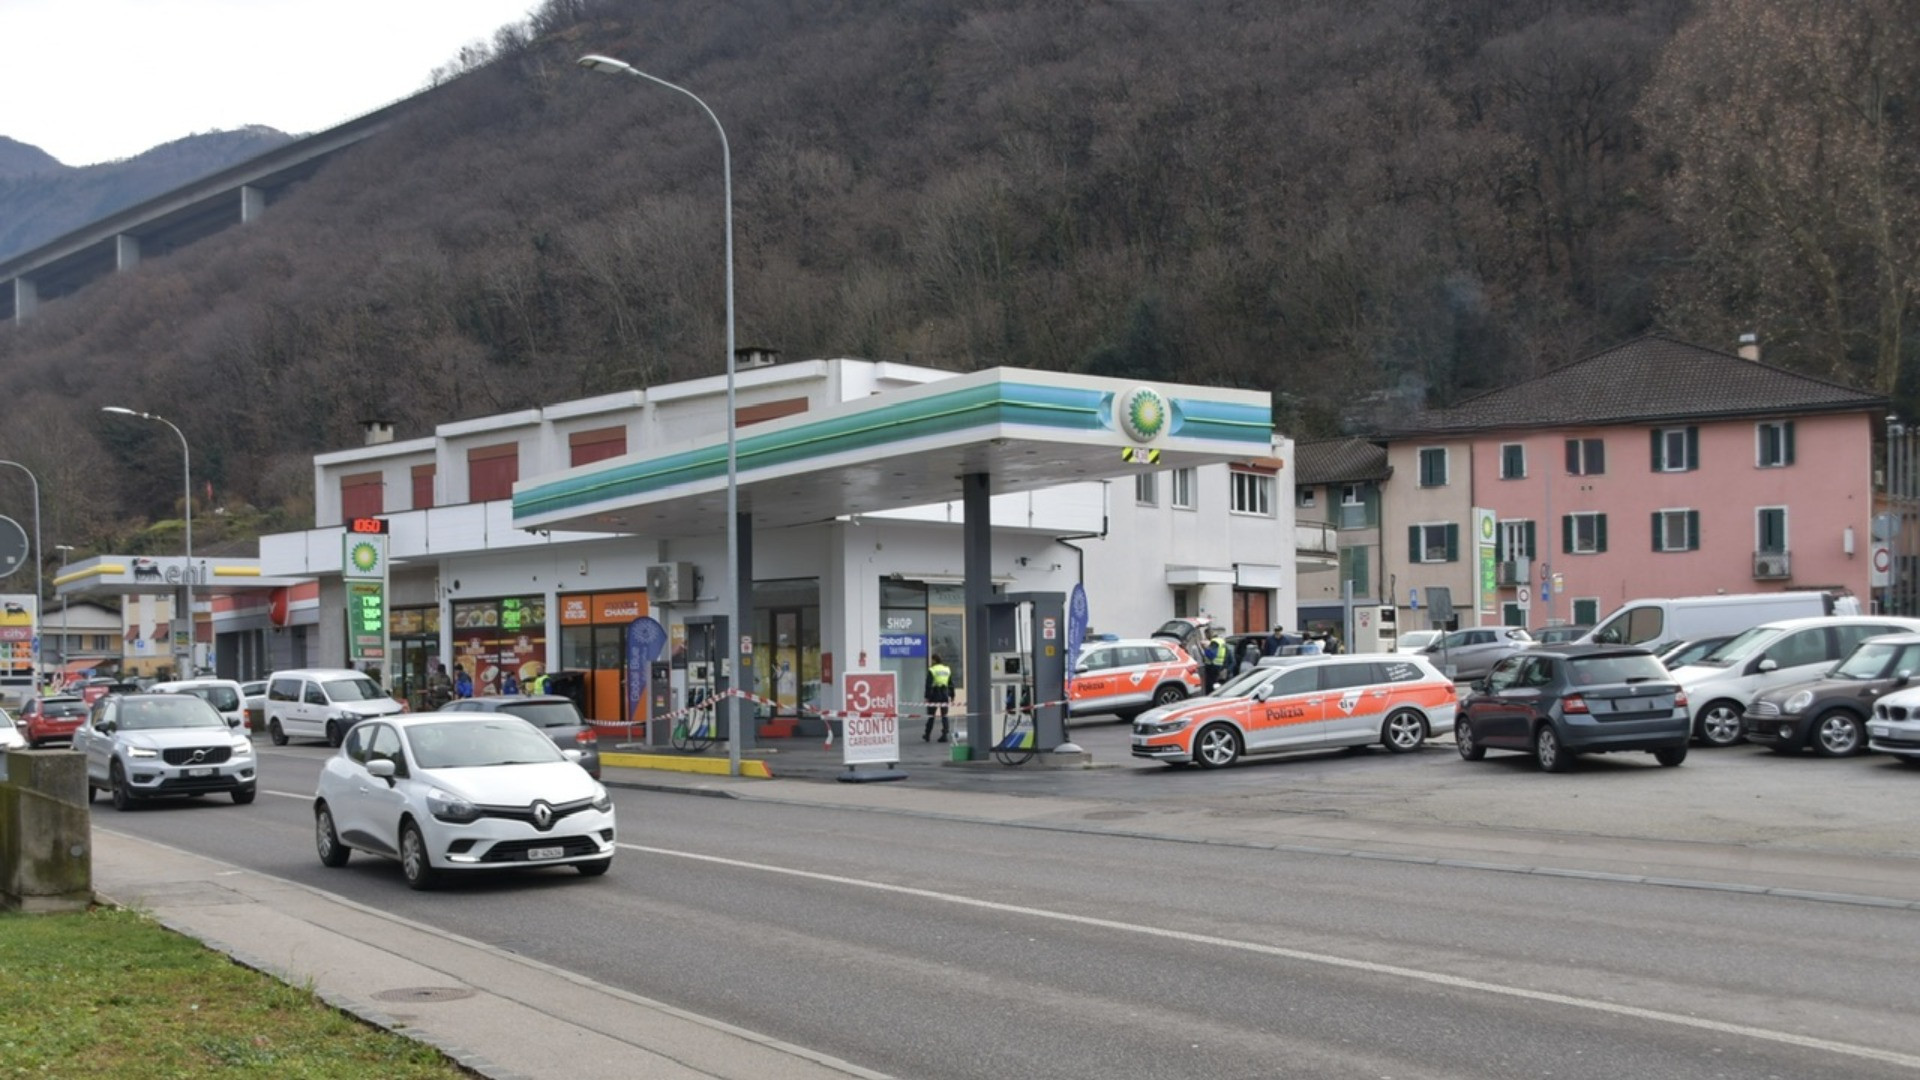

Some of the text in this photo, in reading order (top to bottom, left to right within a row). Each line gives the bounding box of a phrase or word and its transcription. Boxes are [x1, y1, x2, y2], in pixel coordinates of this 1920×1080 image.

[165, 560, 206, 584] eni
[604, 608, 638, 617] CHANGE
[887, 617, 912, 629] SHOP
[3, 630, 27, 639] city
[904, 636, 921, 646] Blue
[1266, 706, 1304, 721] Polizia
[848, 719, 895, 735] SCONTO
[848, 736, 896, 747] CARBURANTE
